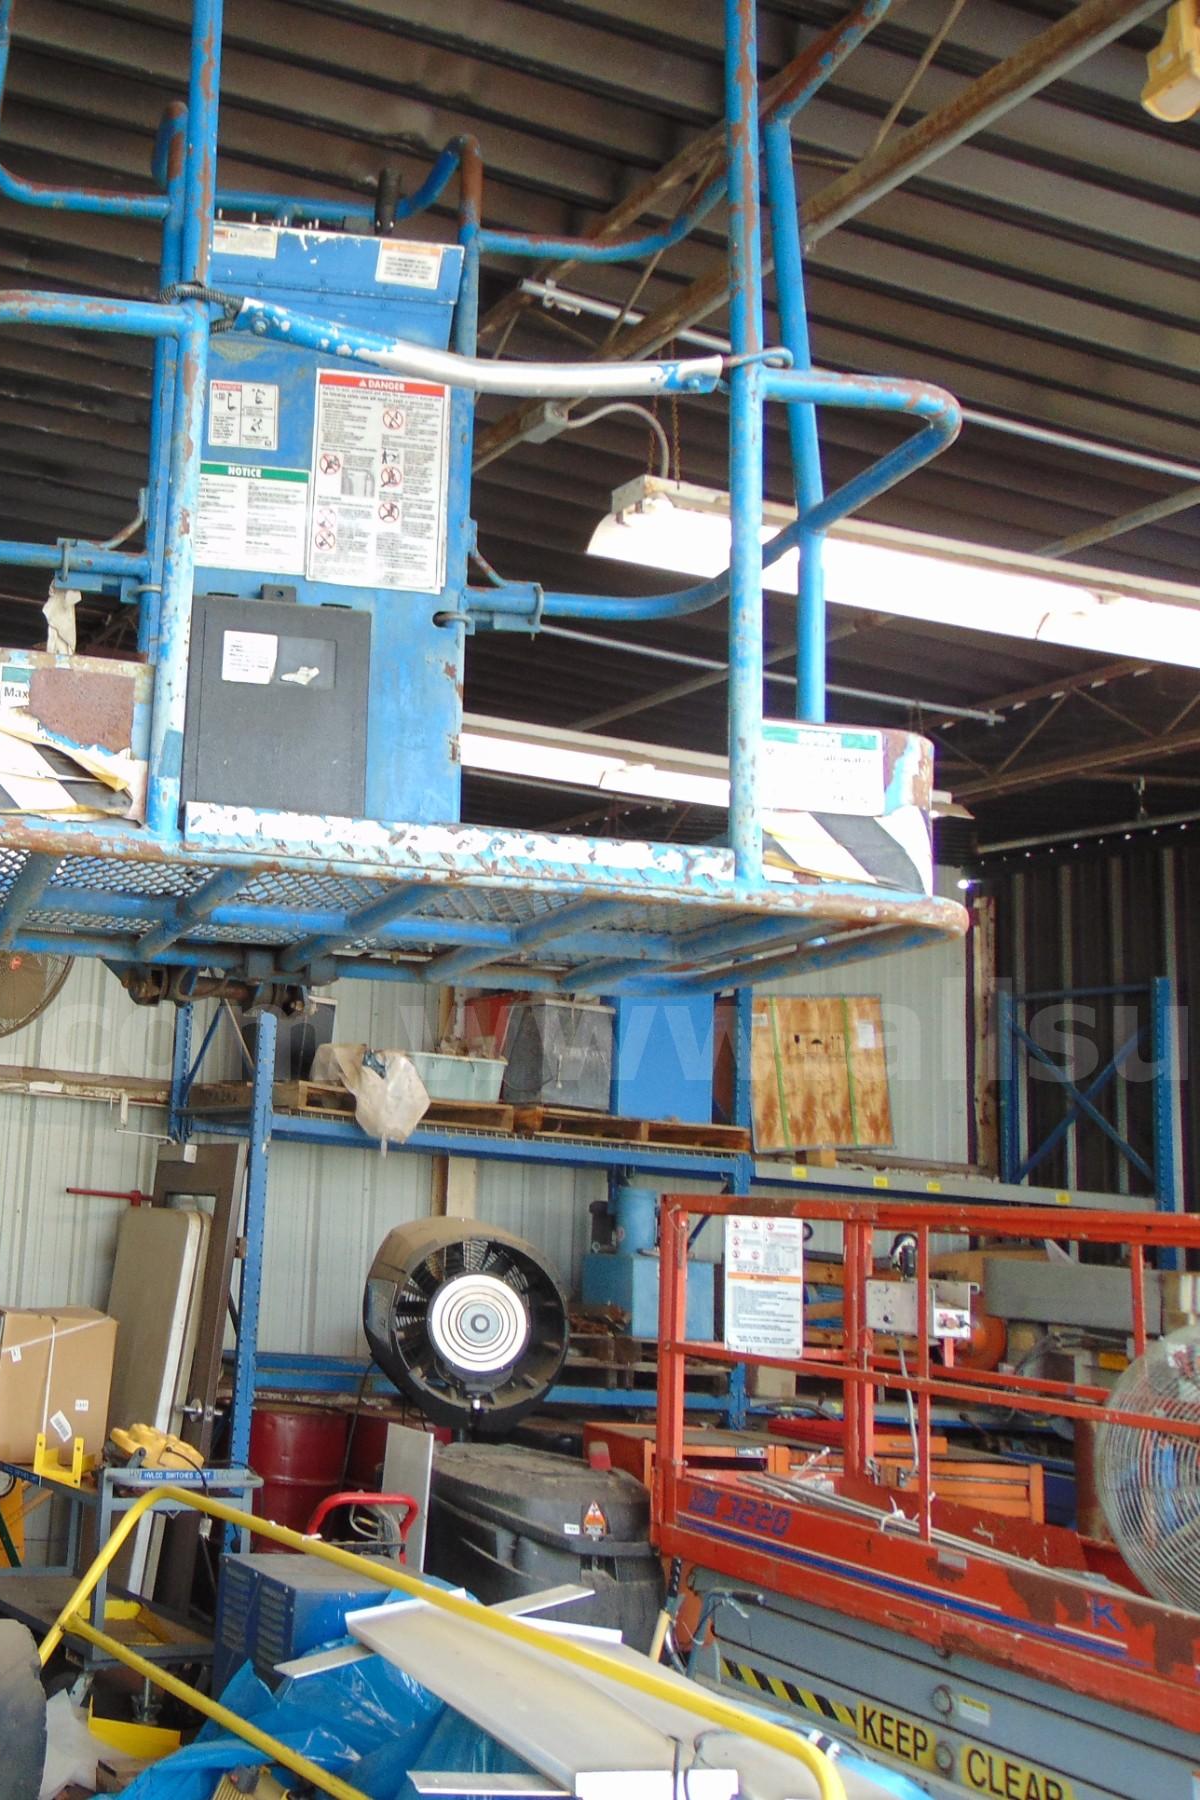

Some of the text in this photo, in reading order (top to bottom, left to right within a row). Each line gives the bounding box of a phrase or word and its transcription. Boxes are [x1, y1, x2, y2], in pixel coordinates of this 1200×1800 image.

[368, 379, 405, 392] DANGER
[227, 465, 262, 478] NOTICE
[862, 1704, 1065, 1800] KEEP CLEAR
